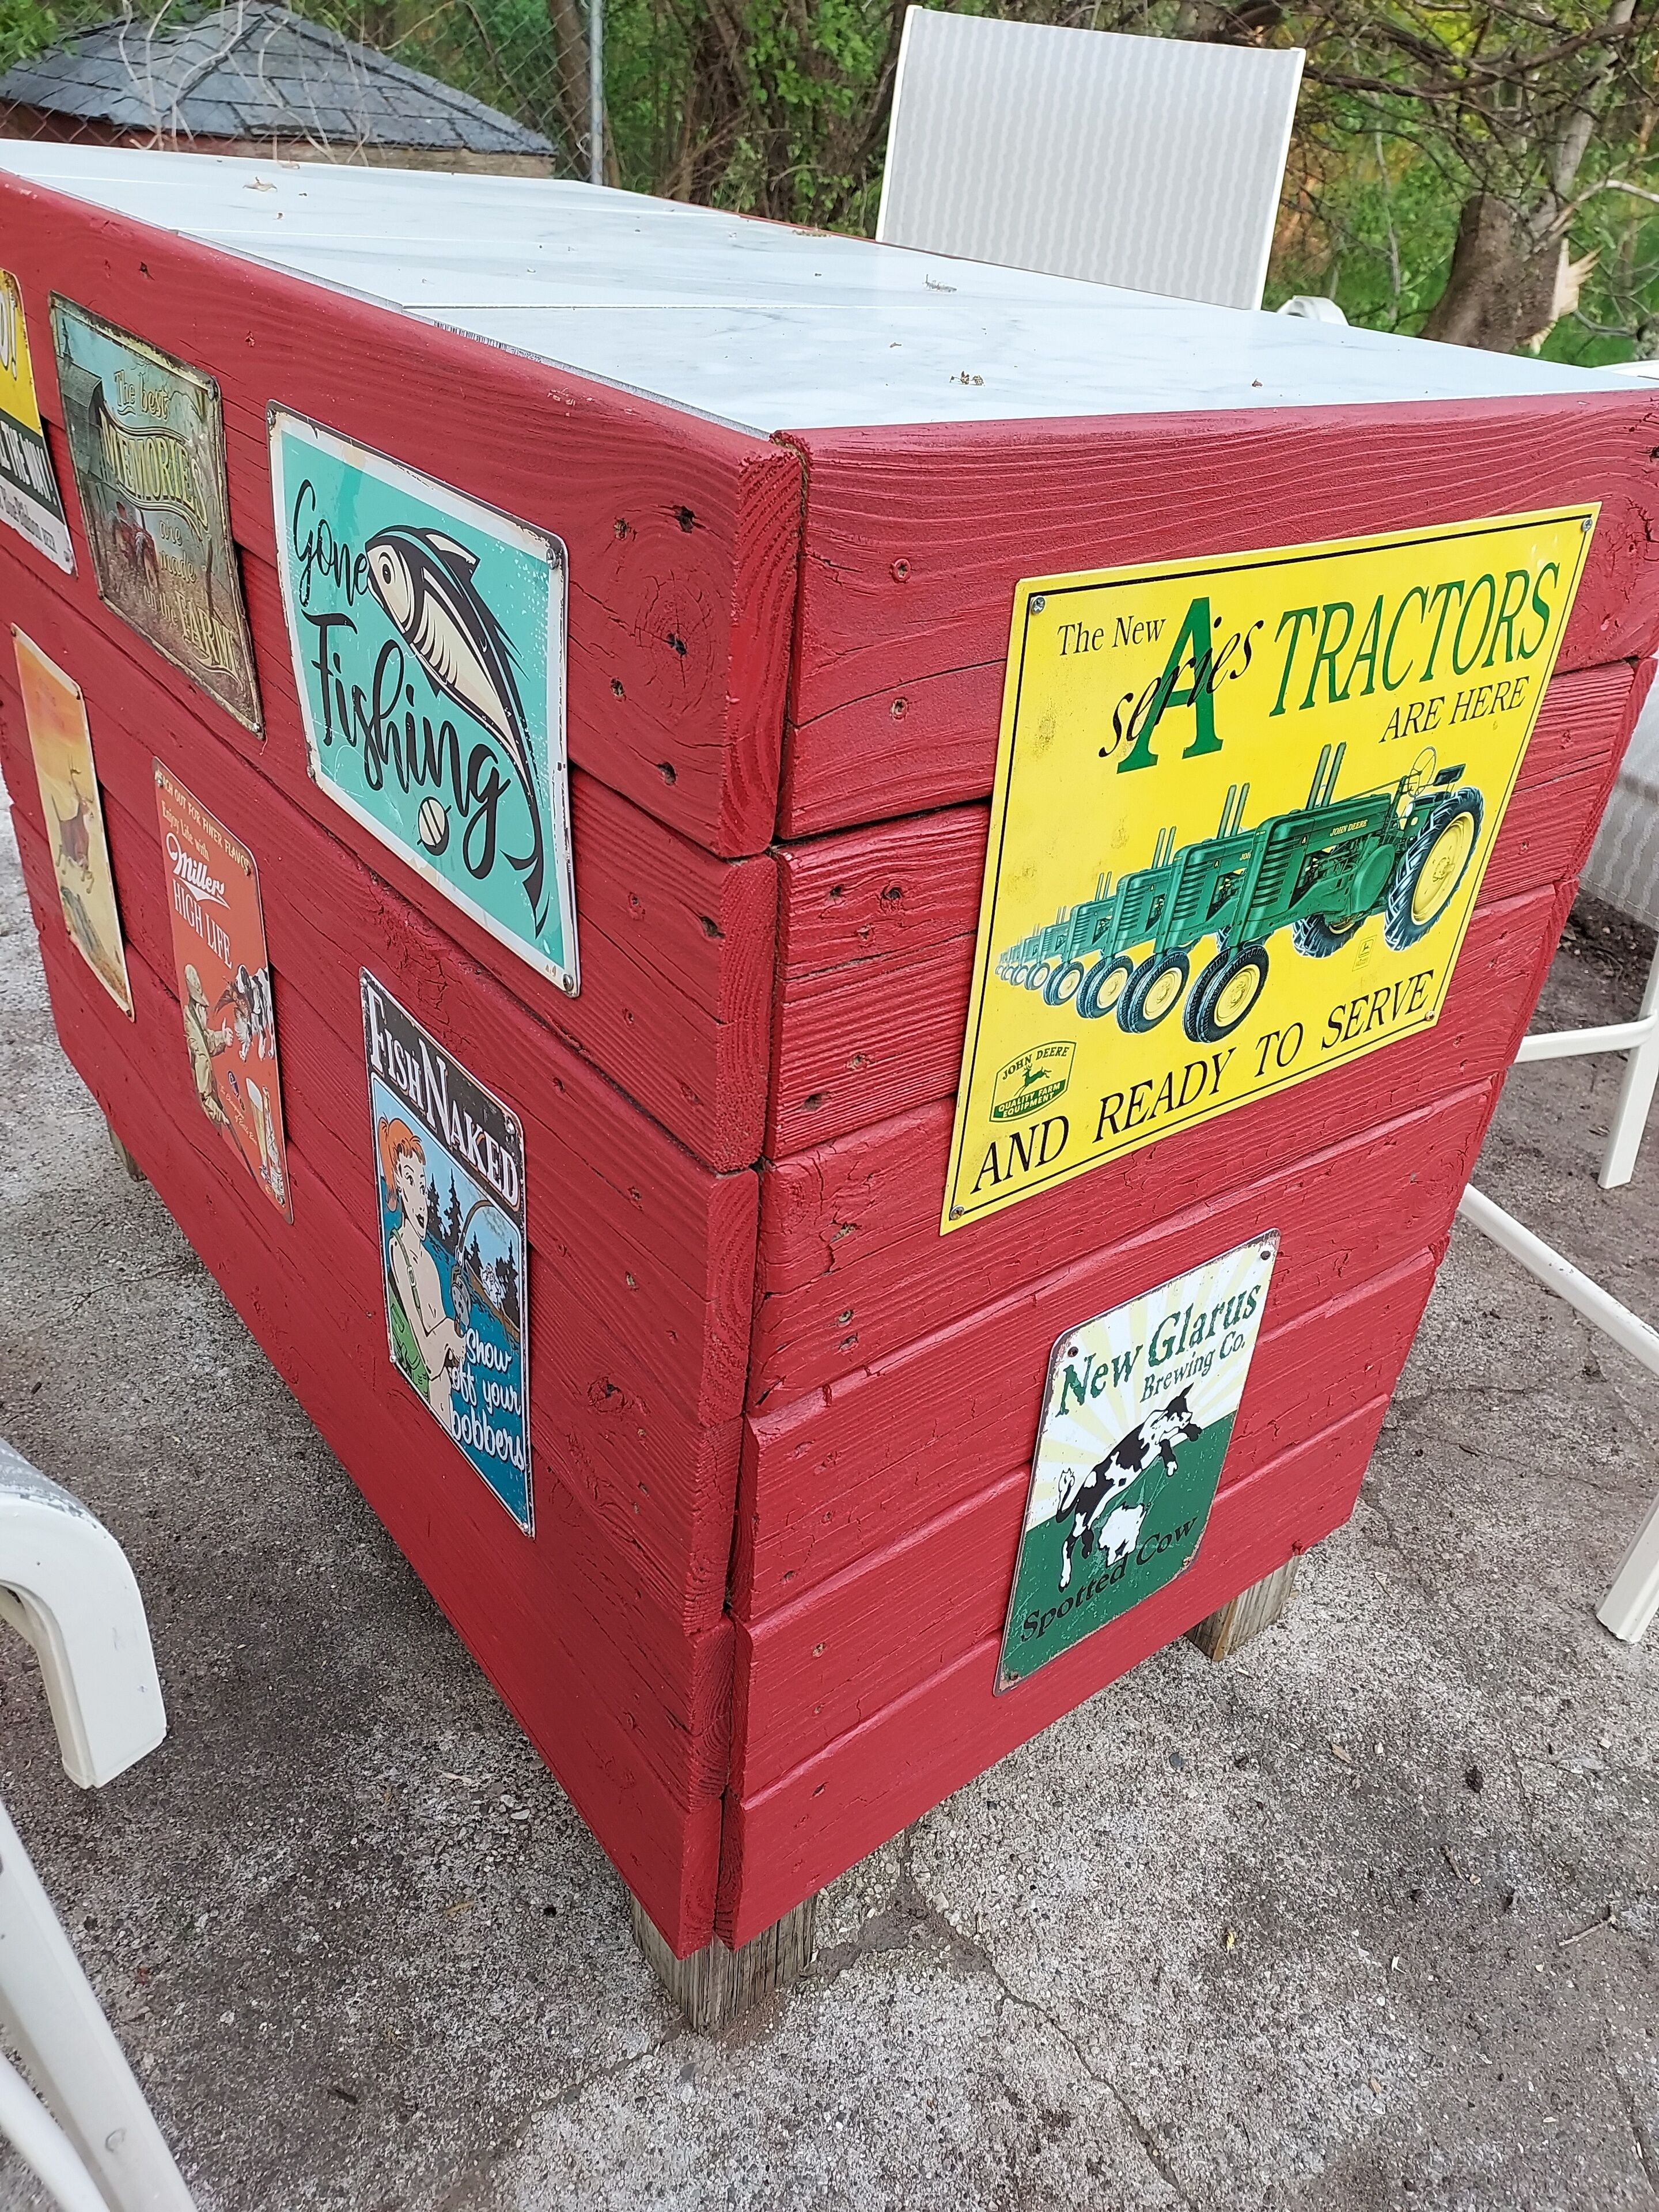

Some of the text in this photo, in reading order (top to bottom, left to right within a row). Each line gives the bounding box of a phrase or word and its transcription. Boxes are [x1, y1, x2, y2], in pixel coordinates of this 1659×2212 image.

[113, 369, 168, 420] The best
[99, 407, 209, 533] MEMORIES
[159, 520, 183, 547] are
[159, 550, 196, 584] made
[291, 478, 369, 608] Gone
[143, 585, 237, 675] on the FARM
[1057, 562, 1561, 775] The New A series TRACTORS
[301, 608, 512, 879] Fishing
[1378, 676, 1530, 743] ARE HERE
[174, 790, 187, 809] OUT
[187, 801, 202, 827] FOR
[202, 817, 223, 848] FINER
[1330, 824, 1348, 837] JOHN
[1347, 819, 1368, 833] DEERE
[165, 832, 225, 896] Miller
[172, 878, 233, 970] HIGH LIFE
[366, 983, 519, 1207] FISH NAKED
[969, 969, 1434, 1196] AND READY TO SERVE
[998, 1082, 1061, 1113] QUALITY FARM
[1002, 1046, 1070, 1081] JOHN DEERE
[1002, 1092, 1055, 1118] EQUIPMENT
[465, 1327, 512, 1373] Show
[1055, 1284, 1262, 1419] New Glarus
[1139, 1330, 1246, 1403] Brewing Co.
[451, 1358, 521, 1416] off your
[448, 1393, 526, 1471] bobbers
[1021, 1516, 1198, 1642] Spotted Cow
